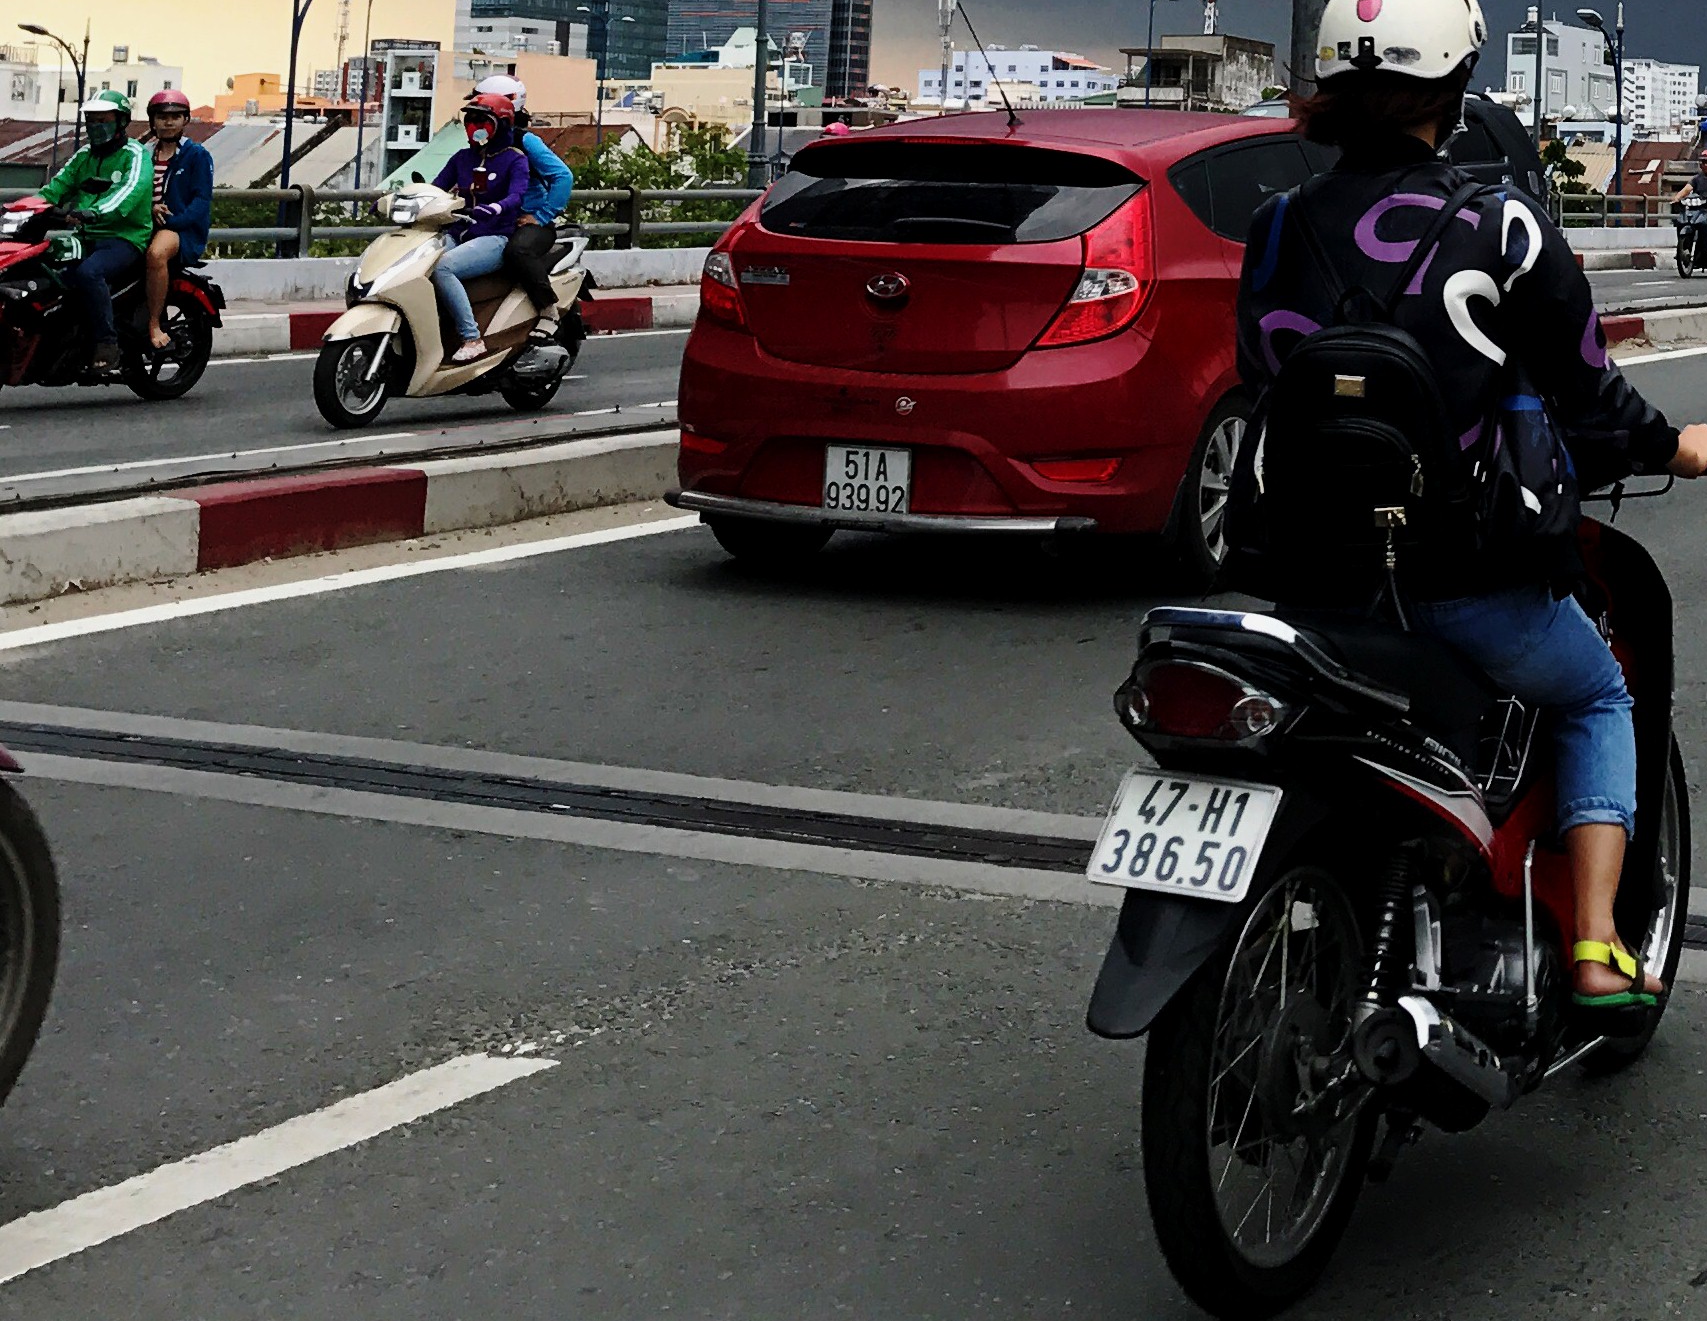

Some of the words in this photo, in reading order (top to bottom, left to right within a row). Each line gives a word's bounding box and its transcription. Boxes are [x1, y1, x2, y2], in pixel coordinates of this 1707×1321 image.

[845, 450, 888, 482] 51A
[826, 482, 905, 513] 939.92
[1138, 780, 1250, 837] 47-H1
[1101, 829, 1248, 891] 386.50
